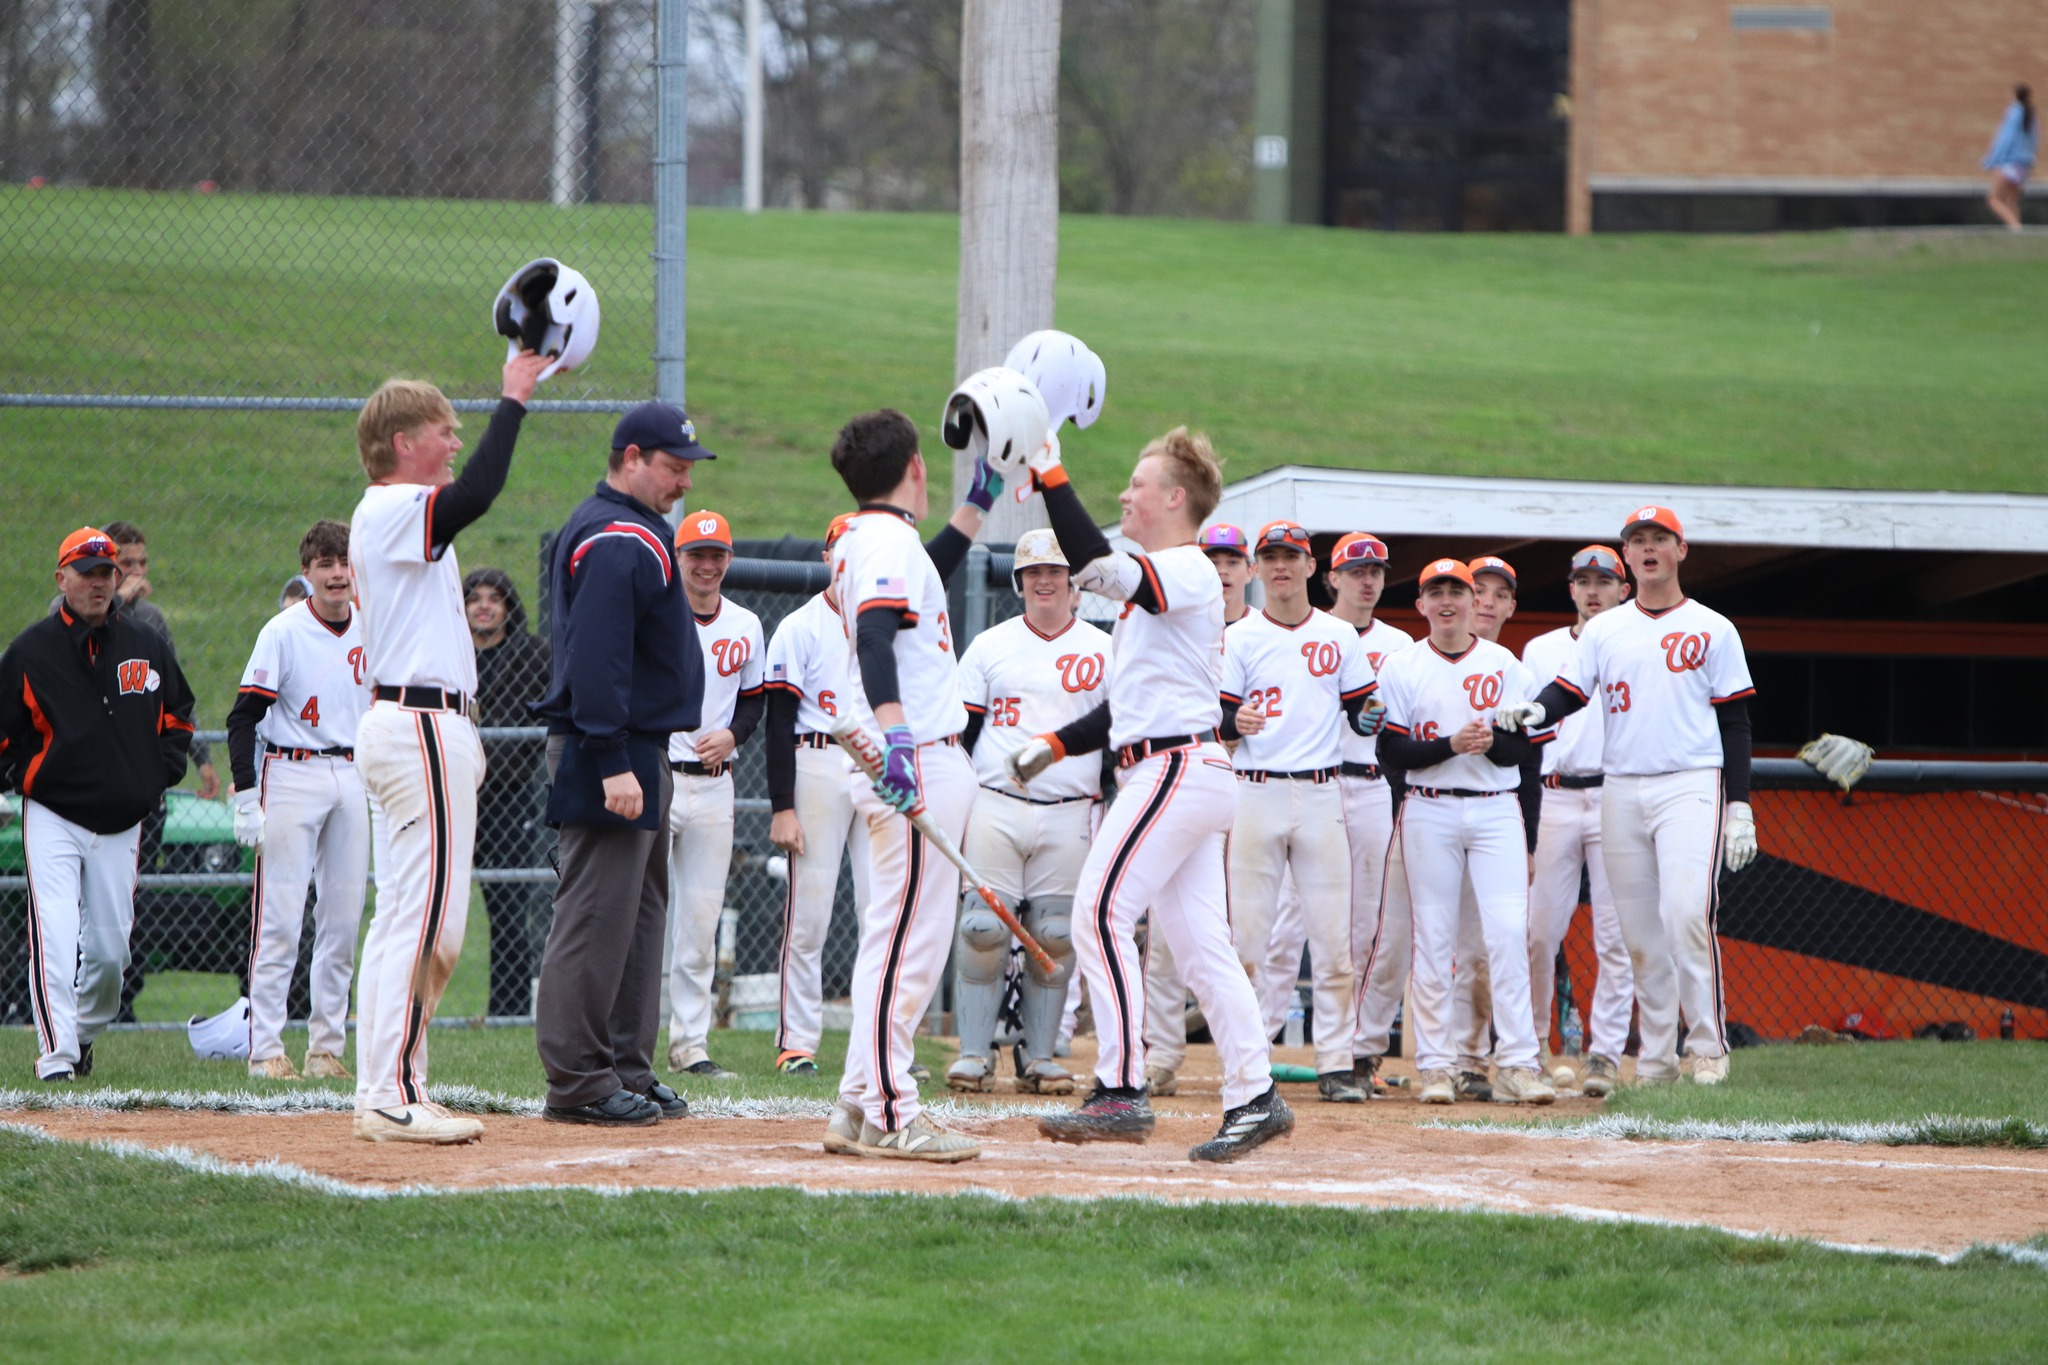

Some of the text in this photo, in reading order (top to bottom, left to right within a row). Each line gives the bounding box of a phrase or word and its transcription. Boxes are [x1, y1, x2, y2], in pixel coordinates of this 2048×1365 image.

[697, 518, 718, 535] W
[1638, 506, 1658, 521] W
[1435, 560, 1455, 574] W
[712, 636, 751, 677] W
[1301, 640, 1343, 677] W
[1661, 631, 1712, 674] W
[116, 658, 150, 695] W
[1056, 652, 1105, 693] W
[818, 689, 838, 717] 6
[1463, 670, 1504, 711] W
[1606, 681, 1632, 714] 23
[300, 695, 320, 728] 4
[992, 697, 1022, 727] 25
